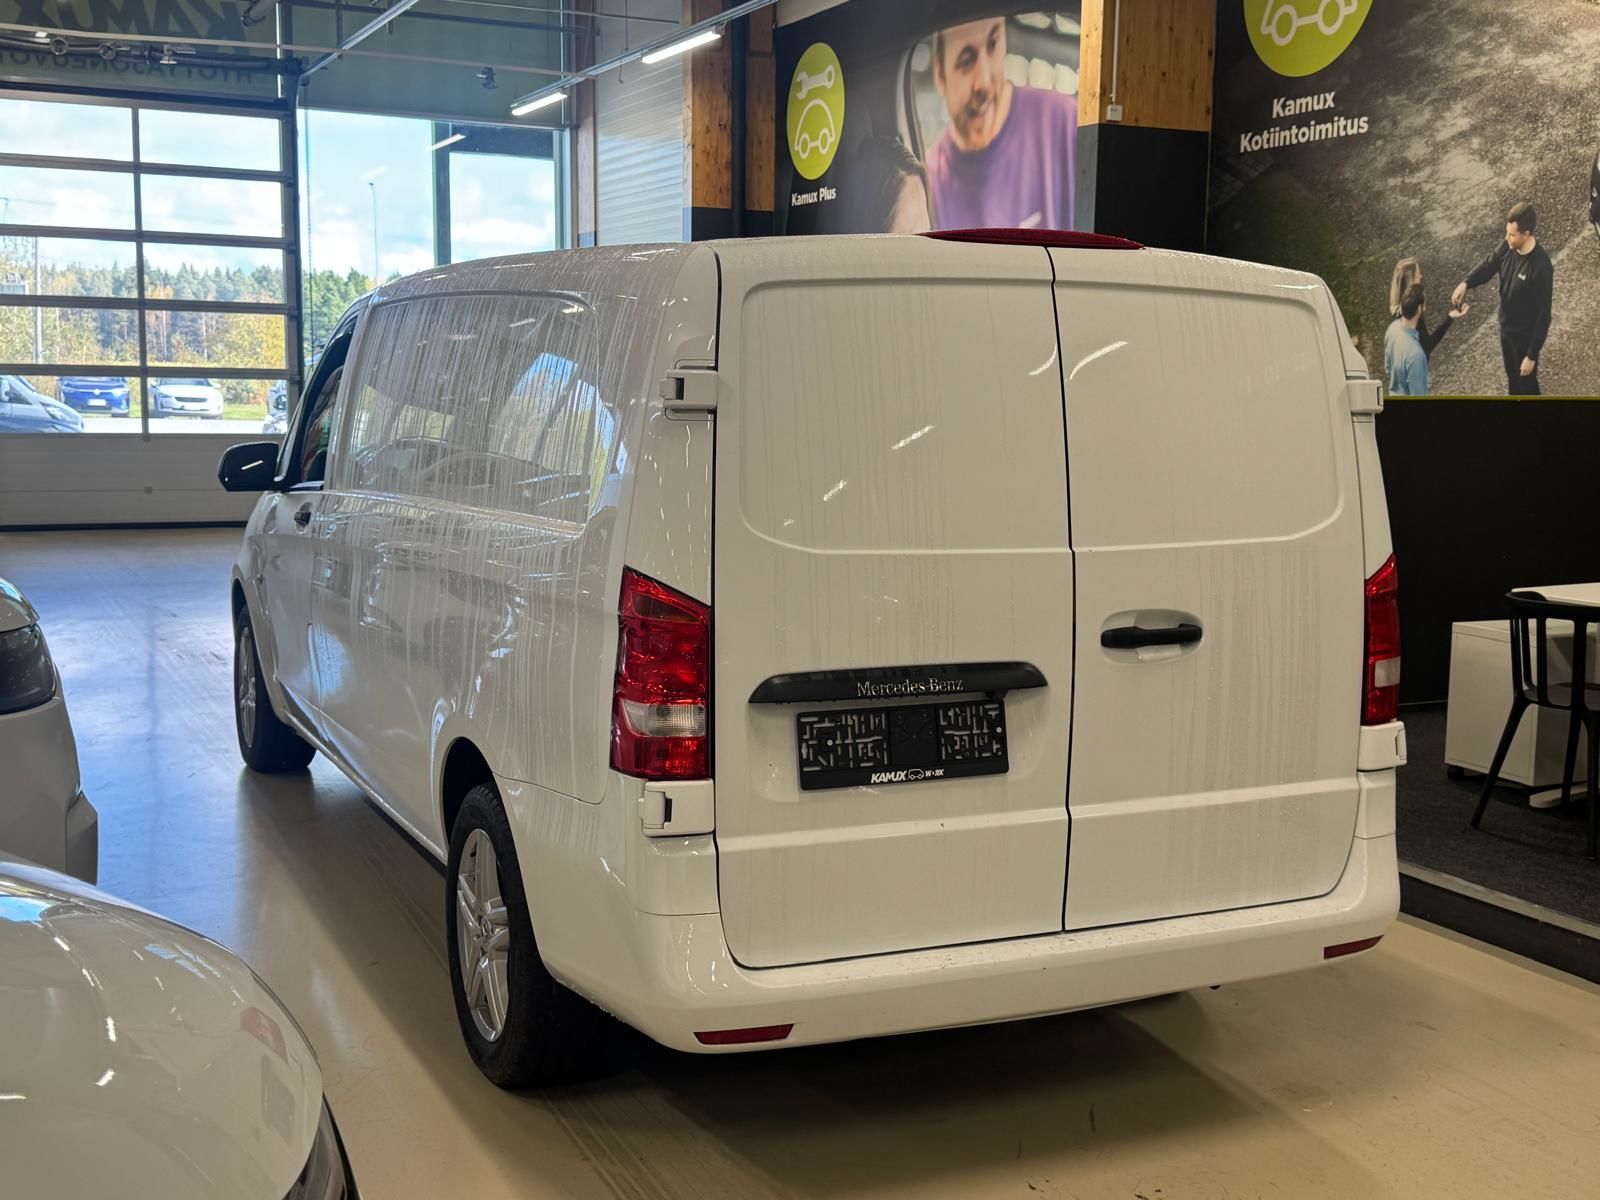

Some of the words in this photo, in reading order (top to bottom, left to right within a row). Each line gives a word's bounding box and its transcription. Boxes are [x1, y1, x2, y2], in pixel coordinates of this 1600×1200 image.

[1272, 91, 1336, 118] Kamux
[1240, 114, 1369, 153] Kotiintoimitus
[791, 191, 818, 207] Kamux
[819, 186, 837, 202] Plus
[857, 678, 964, 697] Mercedes-Benz
[871, 770, 908, 784] KAMUX
